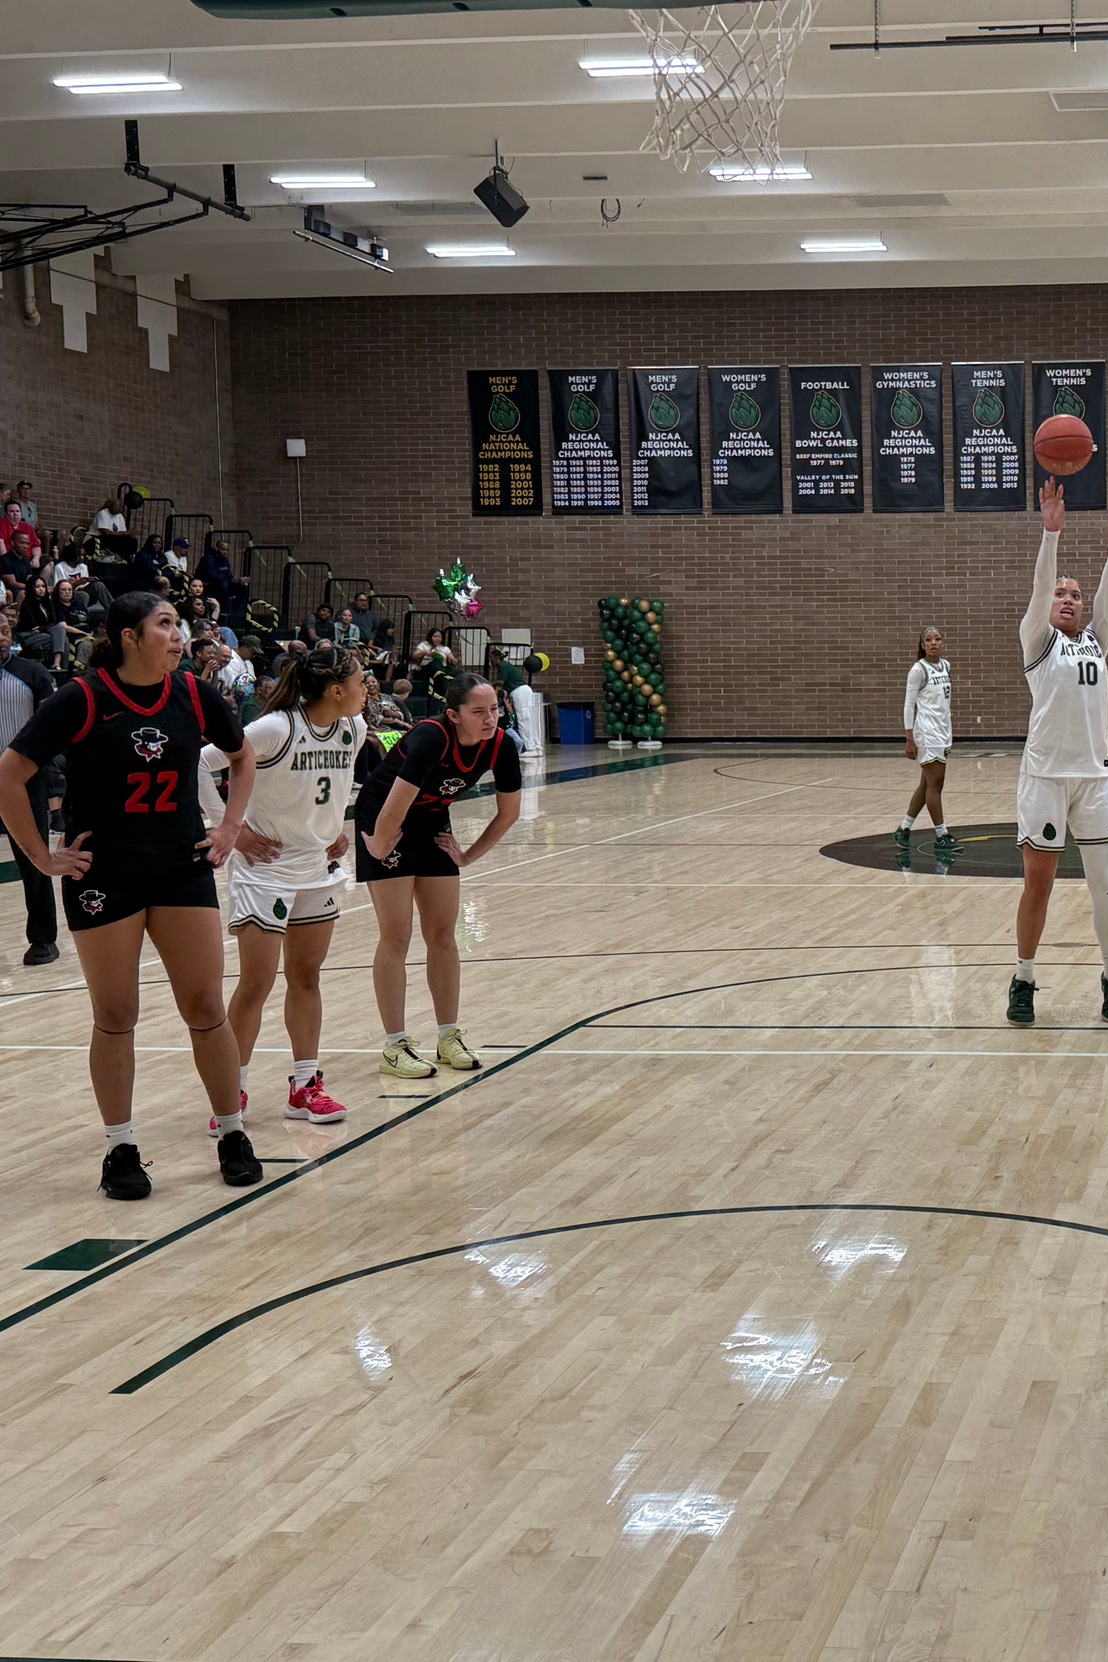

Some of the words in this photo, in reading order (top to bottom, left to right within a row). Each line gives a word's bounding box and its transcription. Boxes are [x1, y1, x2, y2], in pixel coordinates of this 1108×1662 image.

[876, 380, 936, 388] GYMNASTICS
[884, 372, 928, 380] WOMEN'S
[1078, 661, 1098, 686] 10
[125, 771, 178, 812] 22
[315, 777, 331, 806] 3
